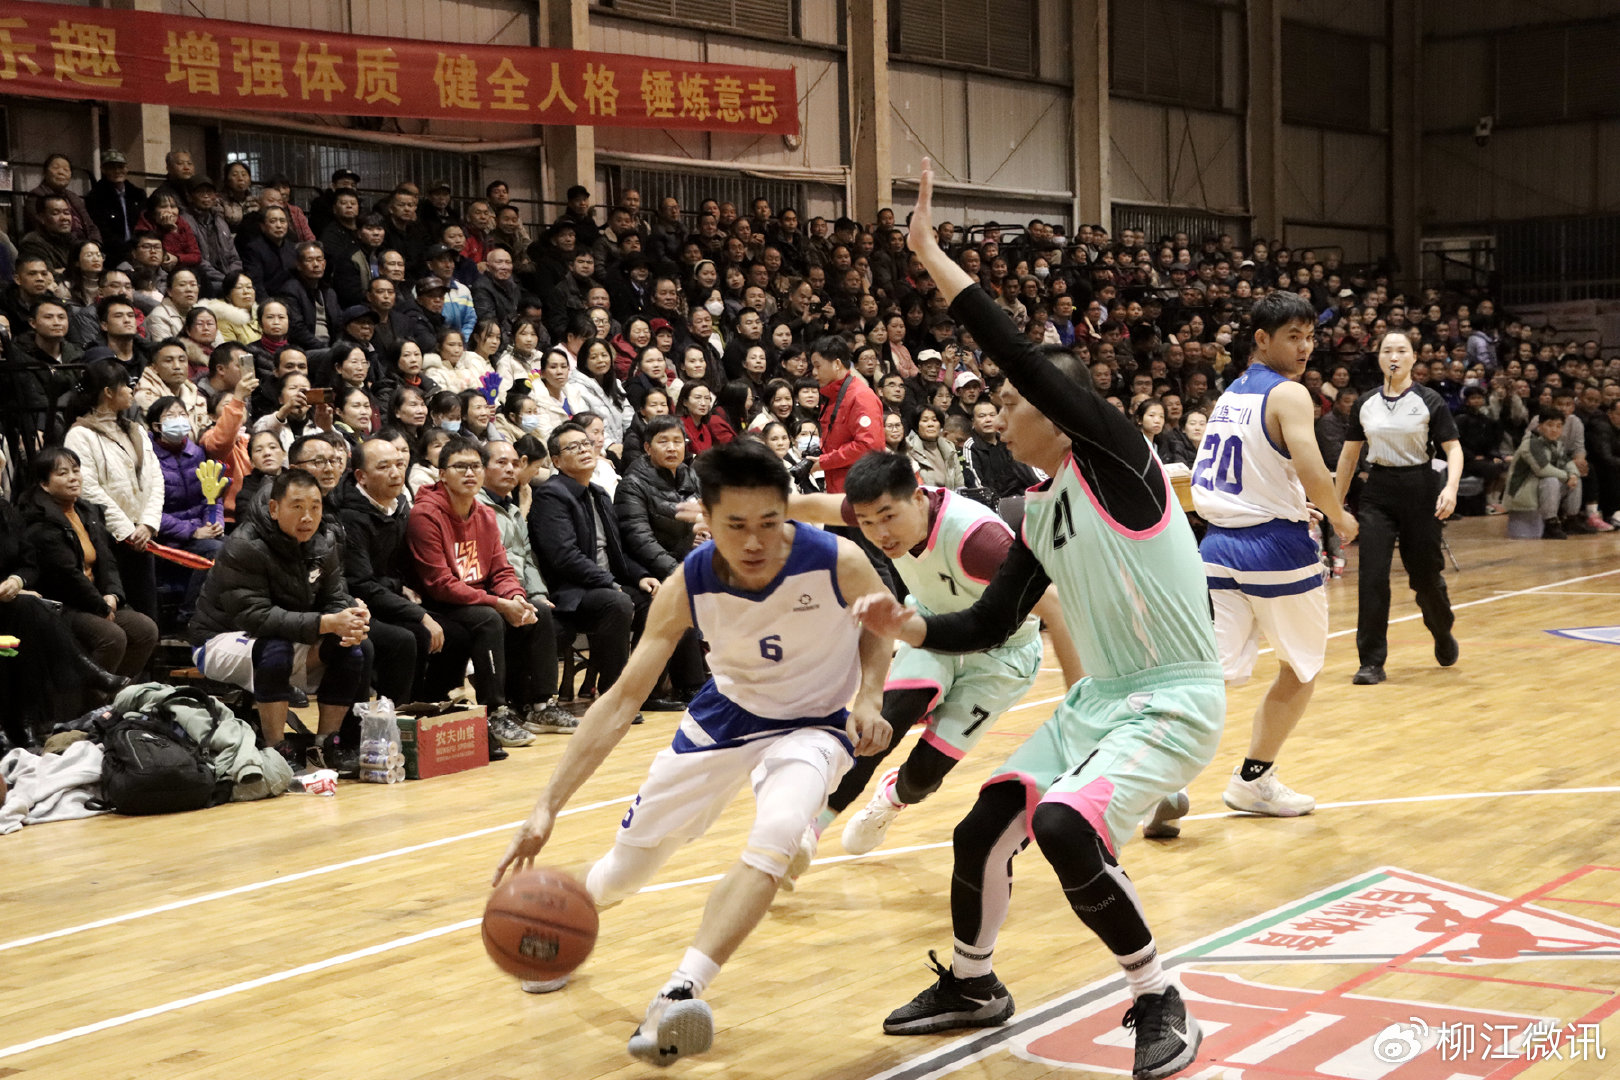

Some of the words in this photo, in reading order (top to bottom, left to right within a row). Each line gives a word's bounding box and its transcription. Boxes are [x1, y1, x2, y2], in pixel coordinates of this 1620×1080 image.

[163, 30, 401, 106] 增强体质
[433, 52, 619, 117] 健全人格
[640, 68, 778, 125] 锤炼意志
[1191, 433, 1243, 495] 20
[1053, 487, 1077, 550] 21
[938, 572, 959, 596] 7
[759, 635, 783, 662] 6
[435, 724, 475, 746] 农夫山泉
[962, 704, 991, 738] 7
